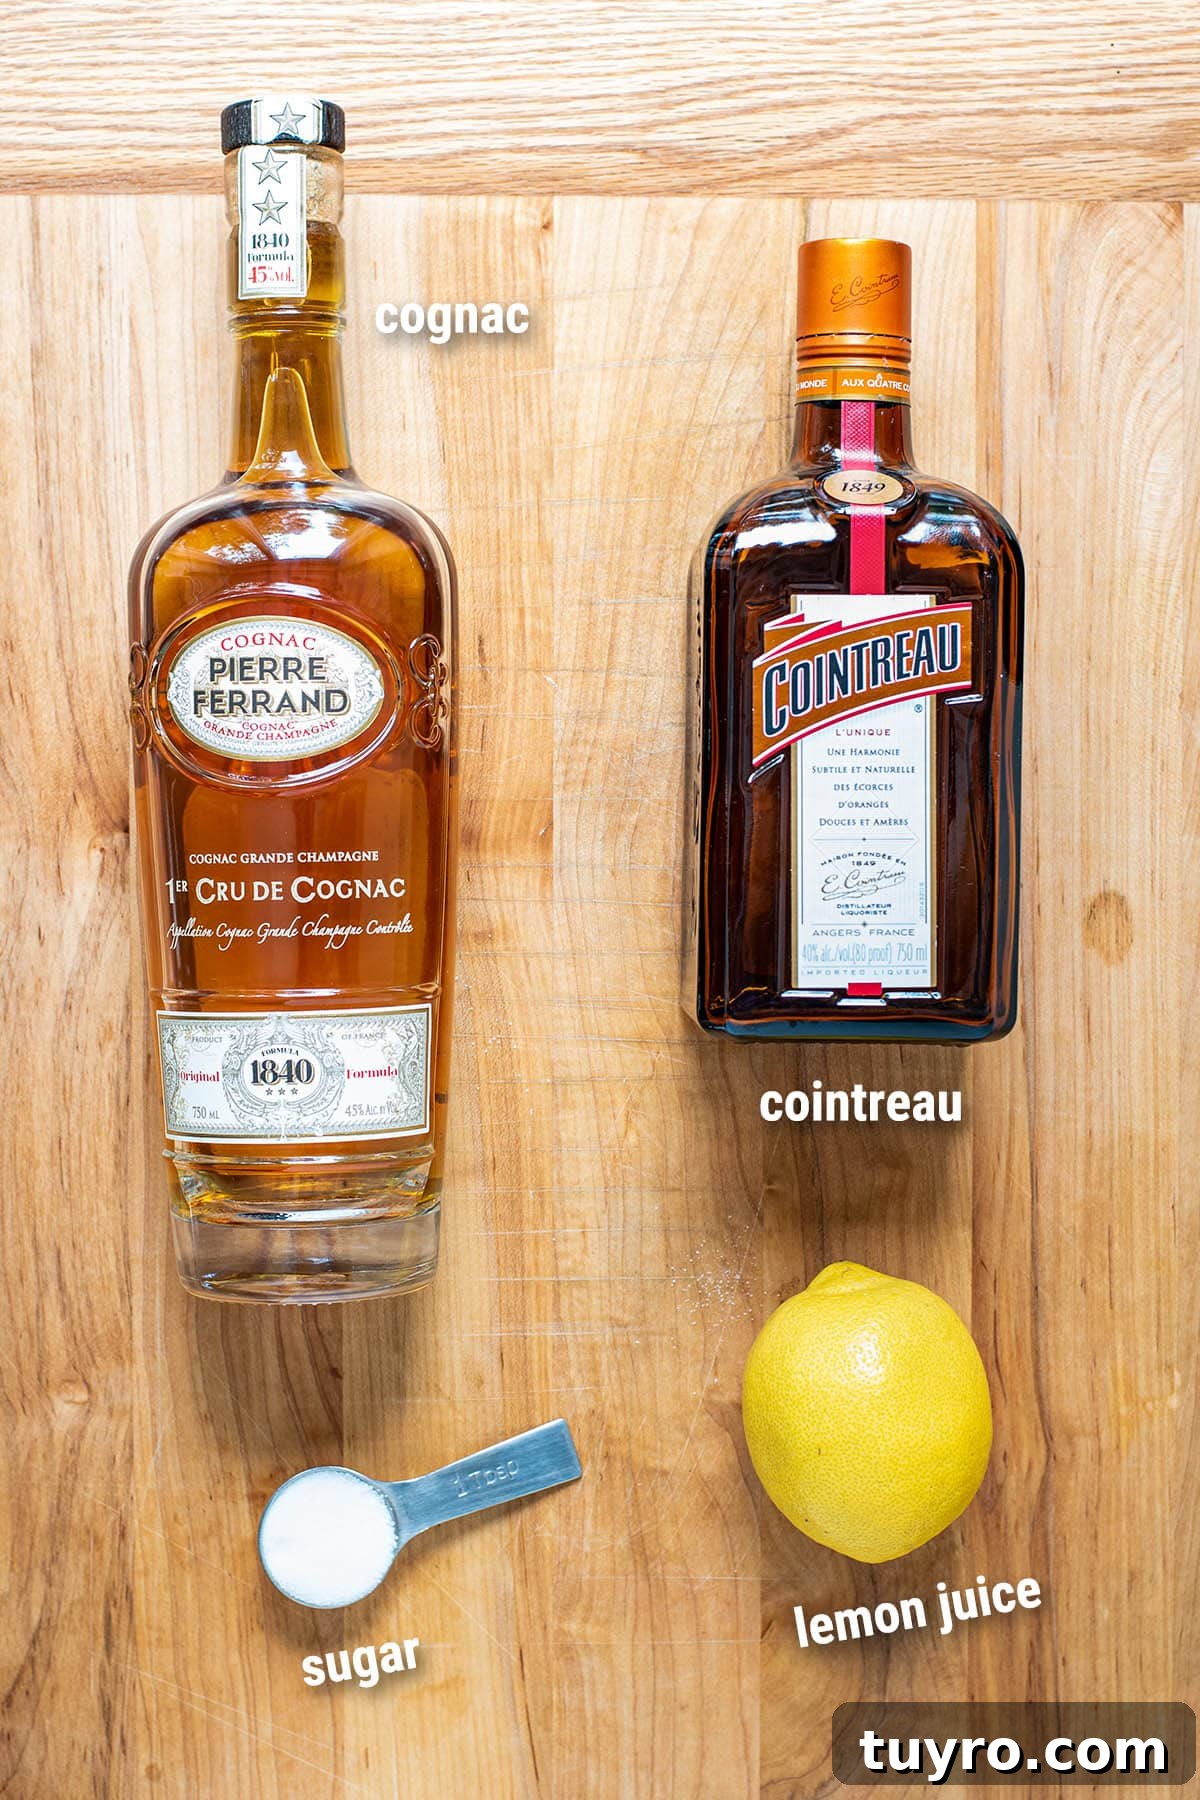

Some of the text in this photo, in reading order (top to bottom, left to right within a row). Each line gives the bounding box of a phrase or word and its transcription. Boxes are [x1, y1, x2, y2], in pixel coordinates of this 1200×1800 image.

[252, 233, 290, 249] 1840
[799, 378, 828, 389] MONDE
[841, 378, 865, 387] AUX
[866, 378, 903, 391] QUATRE
[842, 482, 886, 495] 1849
[220, 632, 317, 652] COGNAC
[208, 656, 328, 684] PIERRE
[762, 622, 961, 738] COINTREAU
[192, 688, 350, 717] FERRAND
[203, 718, 338, 741] GRANDE CHAMPAGNE
[241, 721, 296, 732] COGNAC
[835, 728, 891, 736] L'UNIQUE
[189, 850, 379, 865] COGNAC GRANDE CHAMPAGNE
[820, 851, 907, 866] MAISON FONDÉE EN
[252, 881, 283, 901] DE
[166, 917, 214, 950] Appellation
[215, 922, 254, 951] Cognac
[256, 915, 302, 944] Grande
[301, 913, 363, 950] Champagne
[812, 929, 915, 937] ANGERS FRANCE
[896, 942, 913, 961] 750
[916, 943, 928, 961] ml
[261, 1047, 300, 1058] FORMULA
[180, 1070, 221, 1083] Original
[250, 1058, 315, 1086] 1840
[346, 1065, 399, 1080] Formula
[192, 1105, 207, 1119] 750
[344, 1103, 364, 1117] 45%
[451, 1474, 469, 1499] 1
